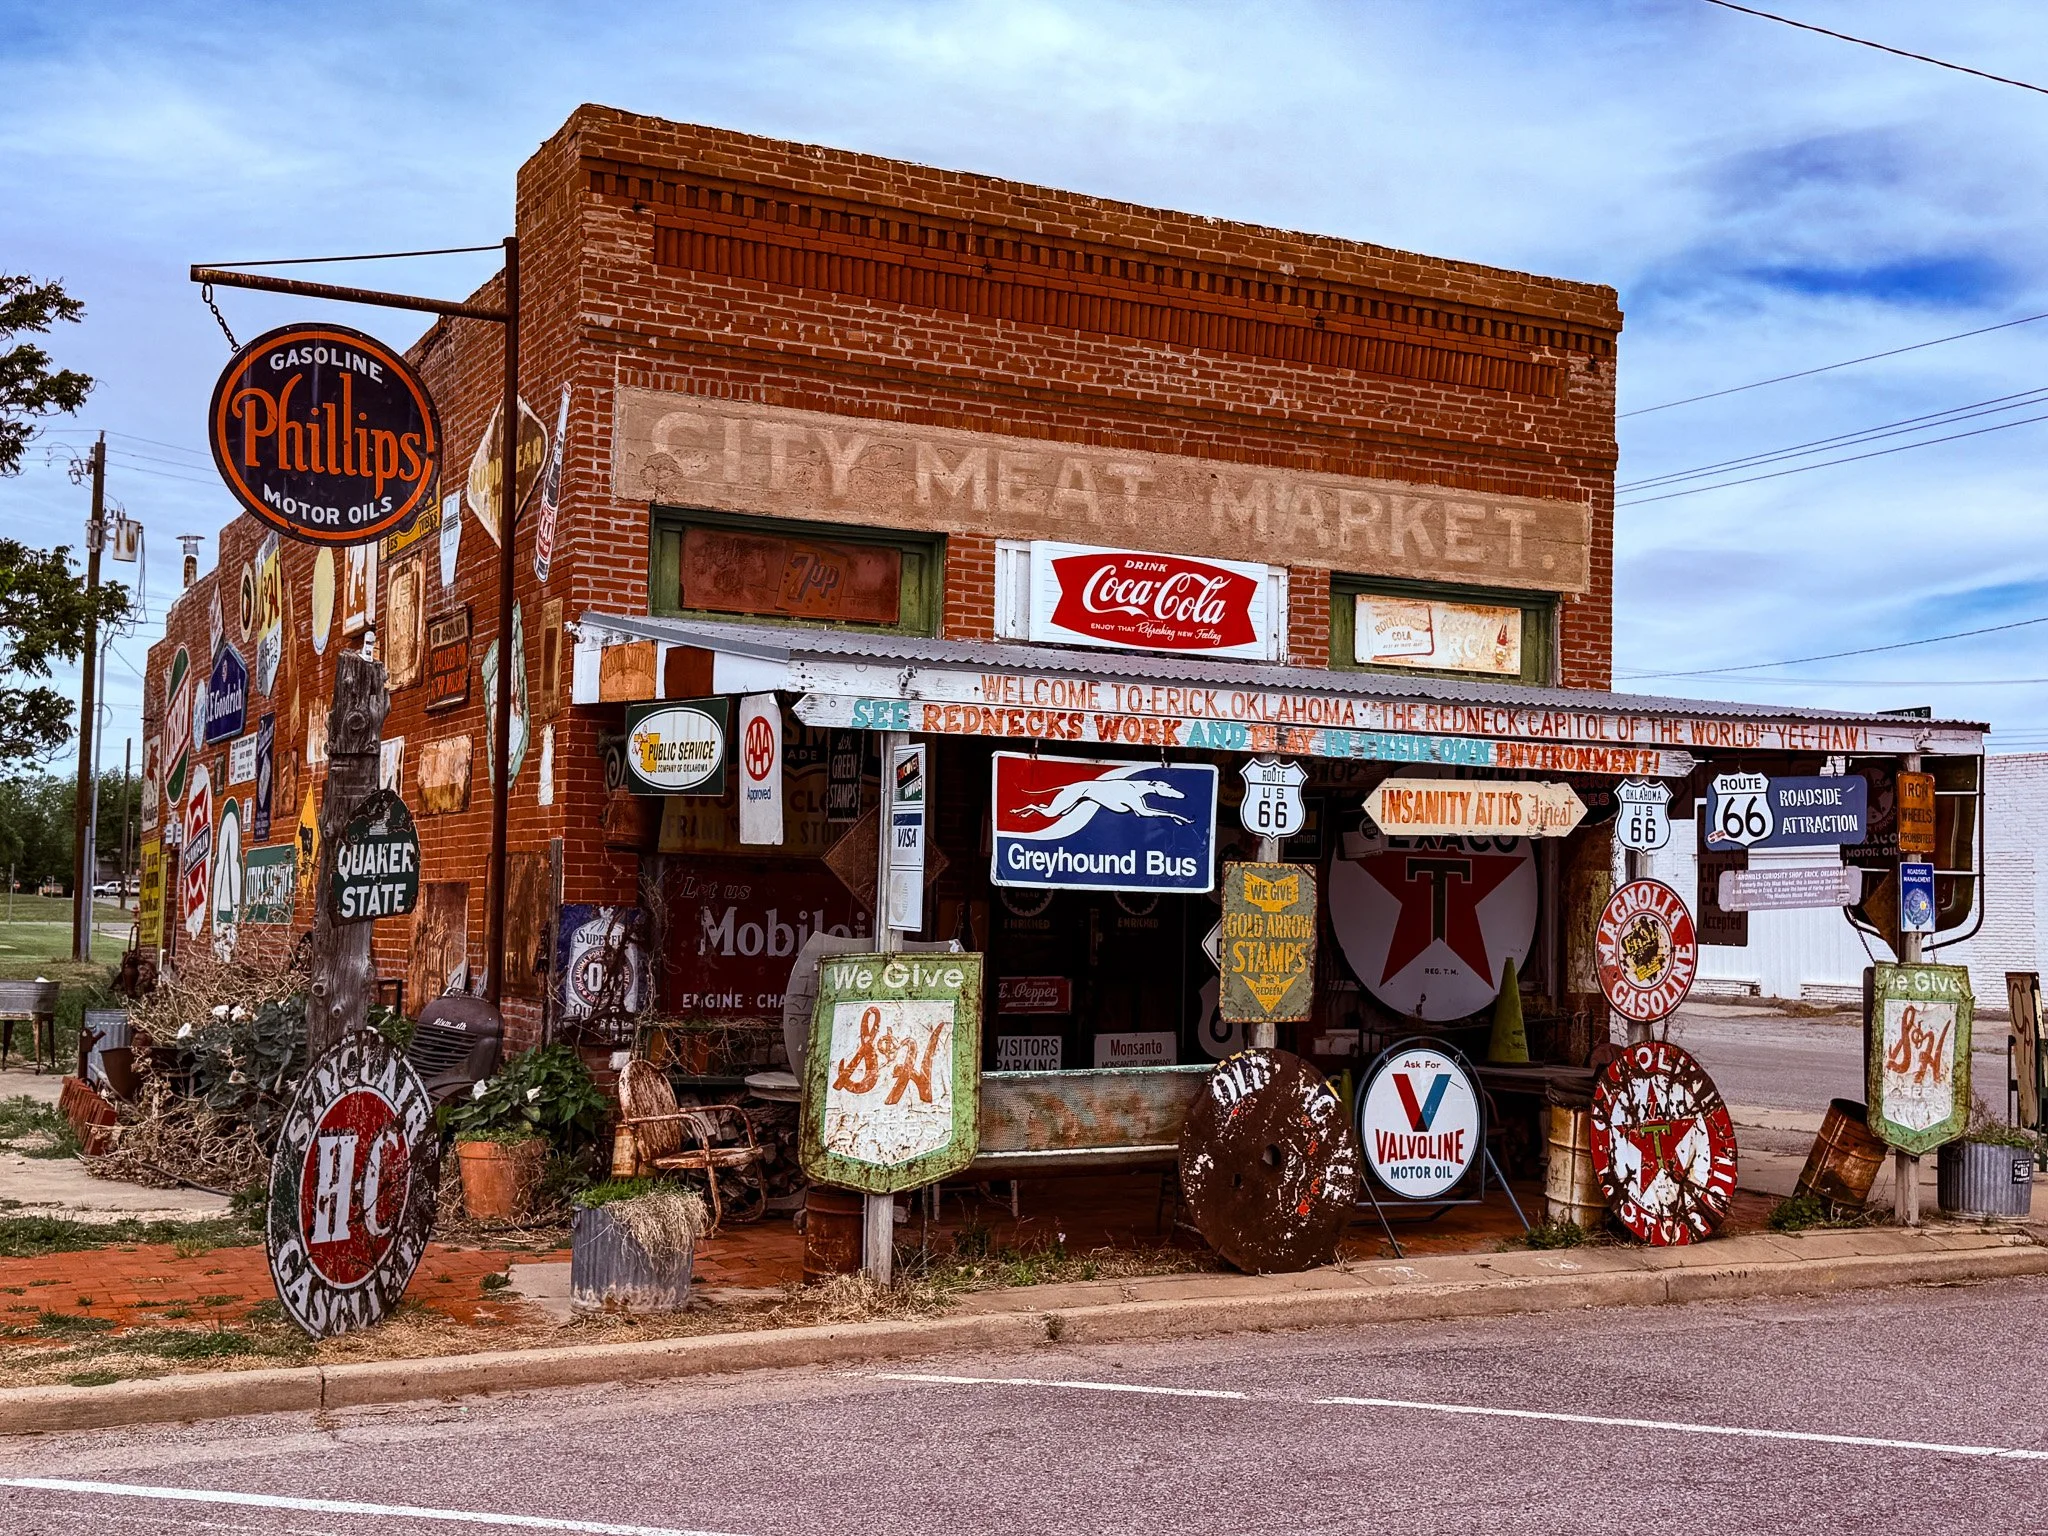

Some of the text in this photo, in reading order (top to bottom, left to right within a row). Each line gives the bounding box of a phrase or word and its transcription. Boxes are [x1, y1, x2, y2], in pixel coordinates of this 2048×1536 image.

[270, 347, 383, 383] GASOLINE
[232, 372, 421, 499] Phillips
[472, 437, 542, 493] GOODEAR
[651, 411, 1556, 570] CITY MEAT MARKET.
[264, 483, 392, 525] MOTOR OILS
[1124, 560, 1168, 572] DRINK
[1082, 564, 1232, 624] Coca-Cola
[1090, 622, 1115, 631] ENJOY
[1136, 622, 1176, 640] Refreshing
[1177, 630, 1193, 638] NEW
[1194, 628, 1222, 644] Feeling
[981, 674, 1101, 710] WELCOME
[1112, 683, 1143, 713] TO
[1425, 703, 1518, 735] REDNECK
[1527, 714, 1609, 740] CAPITOL
[1618, 718, 1640, 740] OF
[1650, 718, 1684, 744] THE
[1776, 725, 1811, 749] YEE
[746, 721, 773, 775] AAA
[851, 698, 910, 731] SEE
[922, 703, 1084, 738] REDNECKS
[1096, 715, 1182, 745] WORK
[1186, 720, 1247, 749] AND
[1324, 730, 1351, 757] IN
[1360, 733, 1431, 761] THEIR
[1439, 738, 1491, 766] OWN
[1496, 741, 1660, 774] ENVIRONMENT!
[648, 741, 715, 761] PUBLIC SERVICE
[658, 765, 676, 773] COMPANY
[832, 753, 857, 779] GREEN
[1262, 769, 1286, 783] ROUTE
[747, 786, 771, 803] Approved
[830, 784, 859, 809] STAMPS
[1625, 788, 1662, 802] OKLAHOMA
[1720, 778, 1762, 791] ROUTE
[1904, 783, 1928, 798] IRON
[1380, 789, 1468, 825] INSANITY
[1474, 792, 1496, 826] AT
[1779, 788, 1843, 808] ROADSIDE
[1258, 801, 1287, 828] 66
[1722, 795, 1766, 838] 66
[1782, 815, 1858, 835] ATTRACTION
[1900, 807, 1933, 823] WHEELS
[898, 828, 918, 847] VISA
[1630, 818, 1656, 844] 66
[1900, 831, 1933, 844] PROHIBITED
[338, 843, 416, 882] QUAKER
[1007, 842, 1197, 880] Greyhound Bus
[1846, 847, 1879, 857] MOTOR
[681, 876, 752, 899] Let us
[1250, 882, 1293, 901] WE GIVE
[342, 883, 407, 919] STATE
[1227, 912, 1313, 939] GOLD ARROW
[1599, 884, 1685, 966] MAGNOLIA
[1232, 940, 1308, 974] STAMPS
[833, 962, 965, 990] We Give
[1612, 943, 1693, 1018] GASOLINE
[682, 993, 743, 1009] ENGINE
[1013, 980, 1059, 999] Pepper
[997, 1039, 1058, 1056] VISITORS
[1111, 1039, 1162, 1056] Monsanto
[1142, 1058, 1171, 1067] COMPANY
[1404, 1060, 1441, 1069] Ask For
[1375, 1128, 1464, 1165] VALVOLINE
[1391, 1166, 1452, 1179] MOTOR OIL
